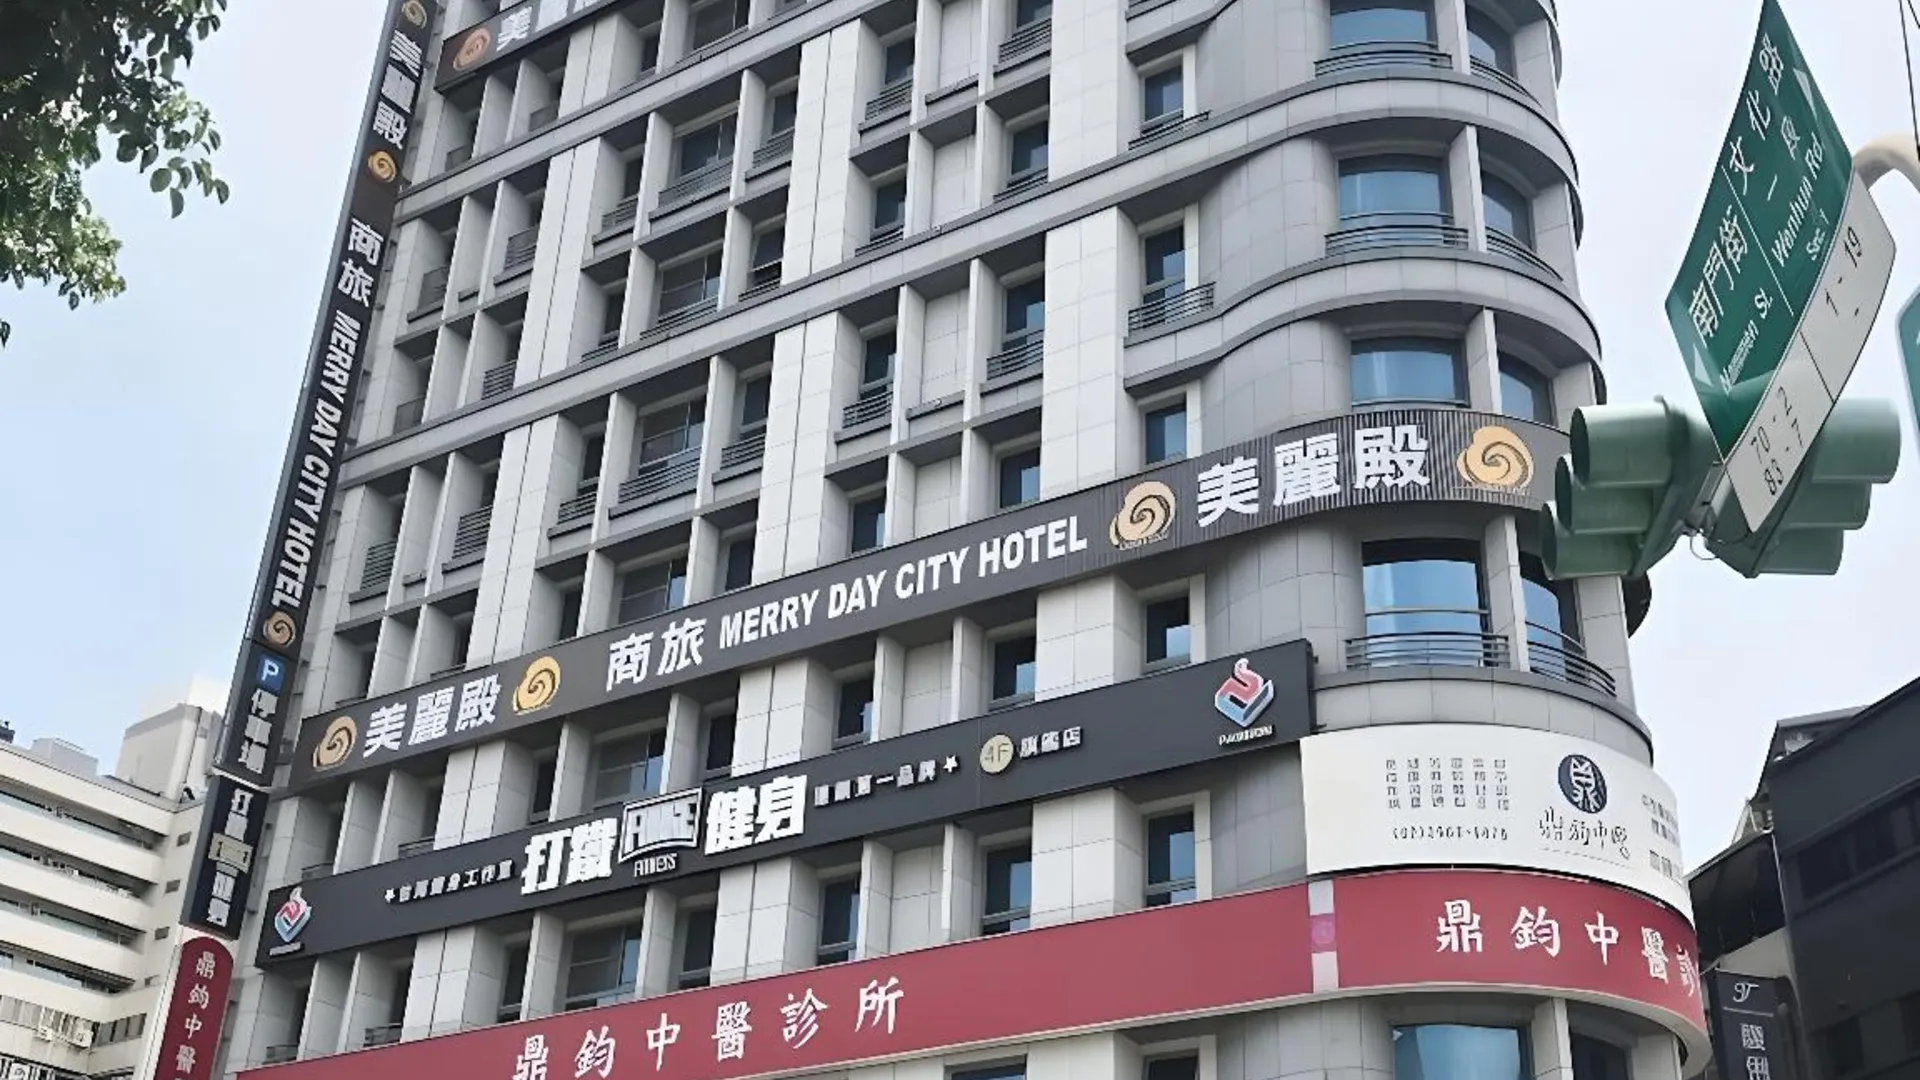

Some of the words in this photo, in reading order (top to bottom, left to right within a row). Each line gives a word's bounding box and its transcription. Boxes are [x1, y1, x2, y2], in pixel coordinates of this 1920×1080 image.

[1729, 32, 1784, 196] 文化路
[1767, 115, 1800, 201] 一段
[336, 217, 384, 308] 商旅
[1688, 204, 1748, 349] 南門街
[319, 309, 364, 403] MERRY
[309, 400, 343, 457] DAY
[293, 454, 332, 523] CITY
[1196, 423, 1431, 528] 美麗殿
[271, 517, 316, 608] HOTEL
[606, 616, 706, 692] 商旅
[718, 588, 820, 650] MERRY
[826, 569, 888, 620] DAY
[895, 546, 970, 600] CITY
[977, 514, 1088, 578] HOTEL
[261, 659, 279, 681] P
[361, 673, 502, 759] 美麗殿
[520, 816, 618, 895] 打鐵
[705, 775, 808, 856] 健身
[174, 950, 216, 1080] 鼎鈞中醫
[511, 975, 905, 1080] 鼎鈞中醫診所
